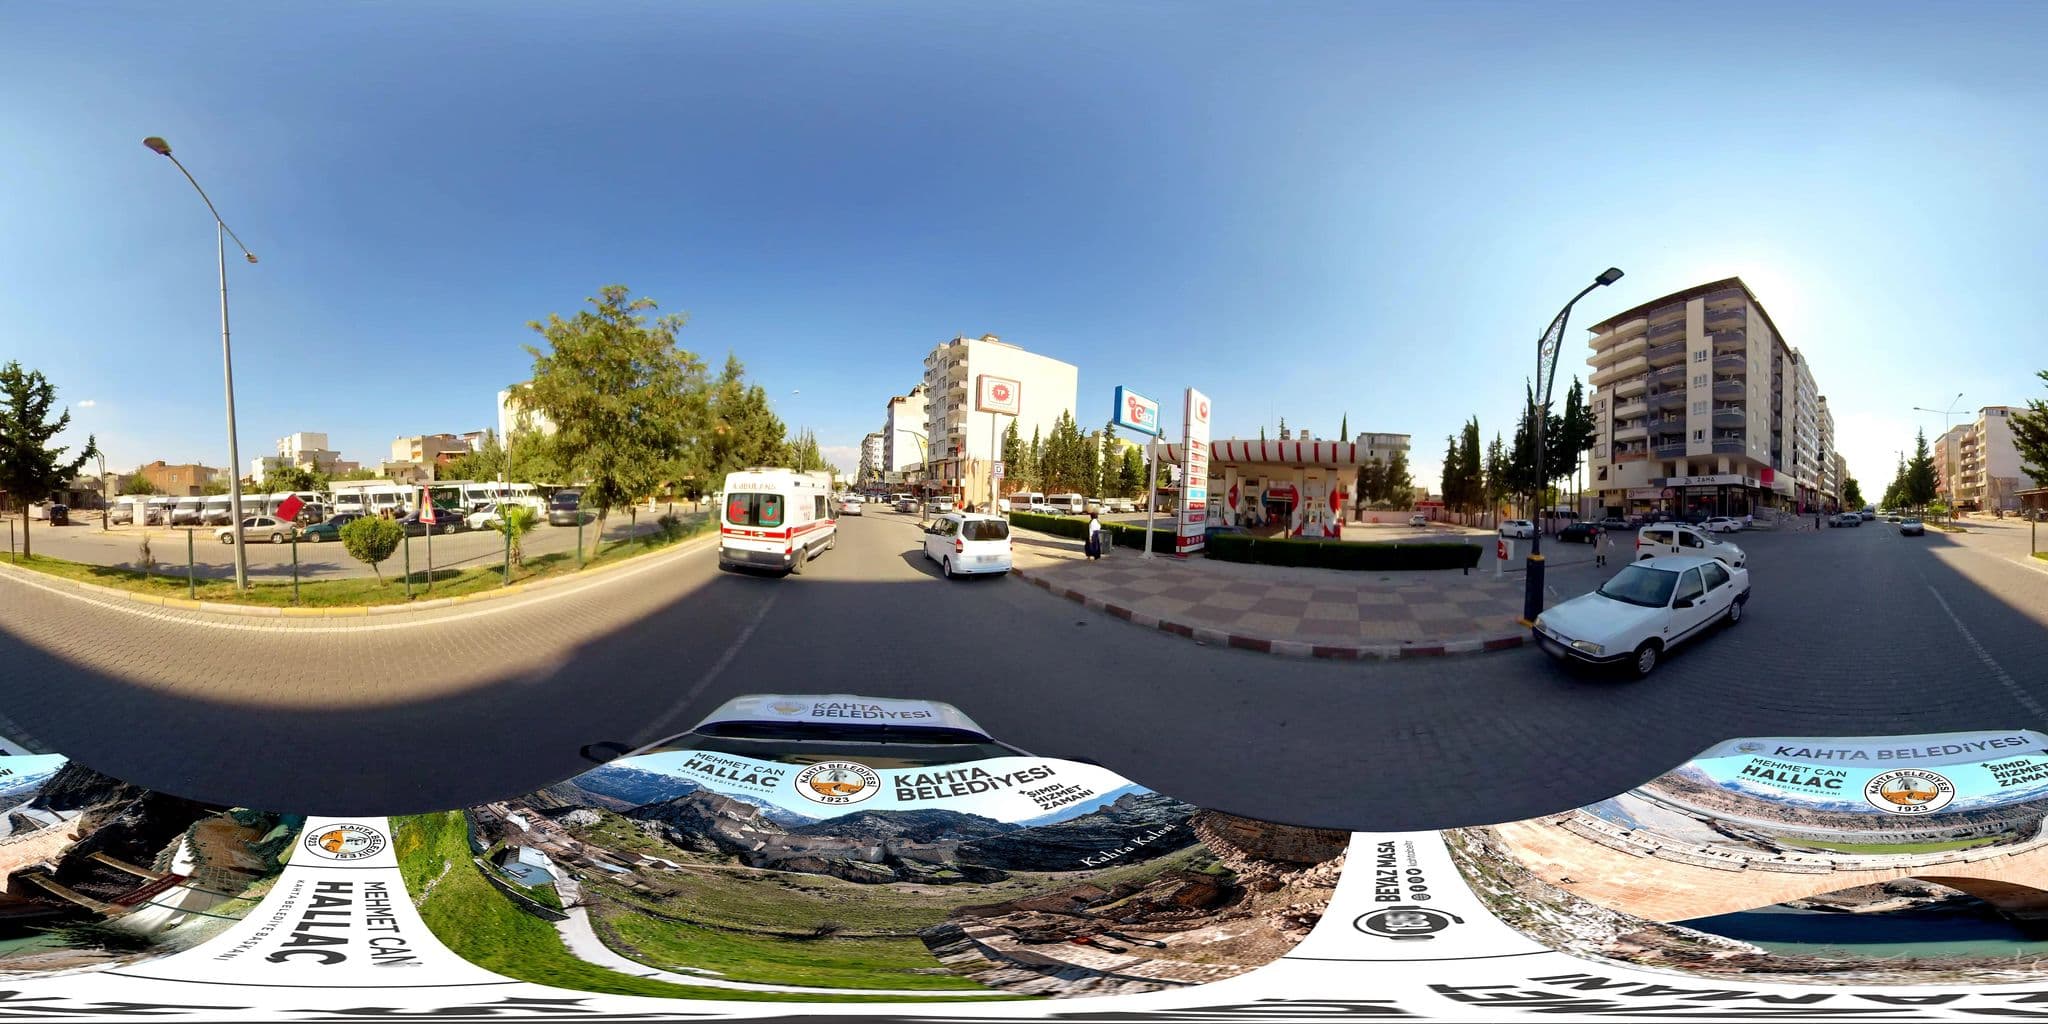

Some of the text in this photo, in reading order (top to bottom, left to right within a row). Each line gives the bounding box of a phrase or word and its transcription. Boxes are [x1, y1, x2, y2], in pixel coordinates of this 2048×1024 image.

[814, 702, 883, 711] KAHTA
[1774, 745, 1870, 761] KAHTA
[1877, 736, 2031, 761] BELEDİYESİ
[694, 752, 785, 776] MEHMET CAN
[800, 765, 826, 784] KAHTA
[1751, 758, 1847, 778] MEHMET CAN
[894, 767, 992, 788] KAHTA
[895, 765, 1057, 802] BELEDİYESİ
[1870, 775, 1894, 794] KAHTA
[1040, 789, 1095, 810] ZAMANI
[1079, 823, 1177, 867] Kahta Kalesi
[1375, 841, 1401, 902] BEYAZ MASA
[288, 879, 305, 899] KAHTA
[364, 881, 401, 933] MEHMET
